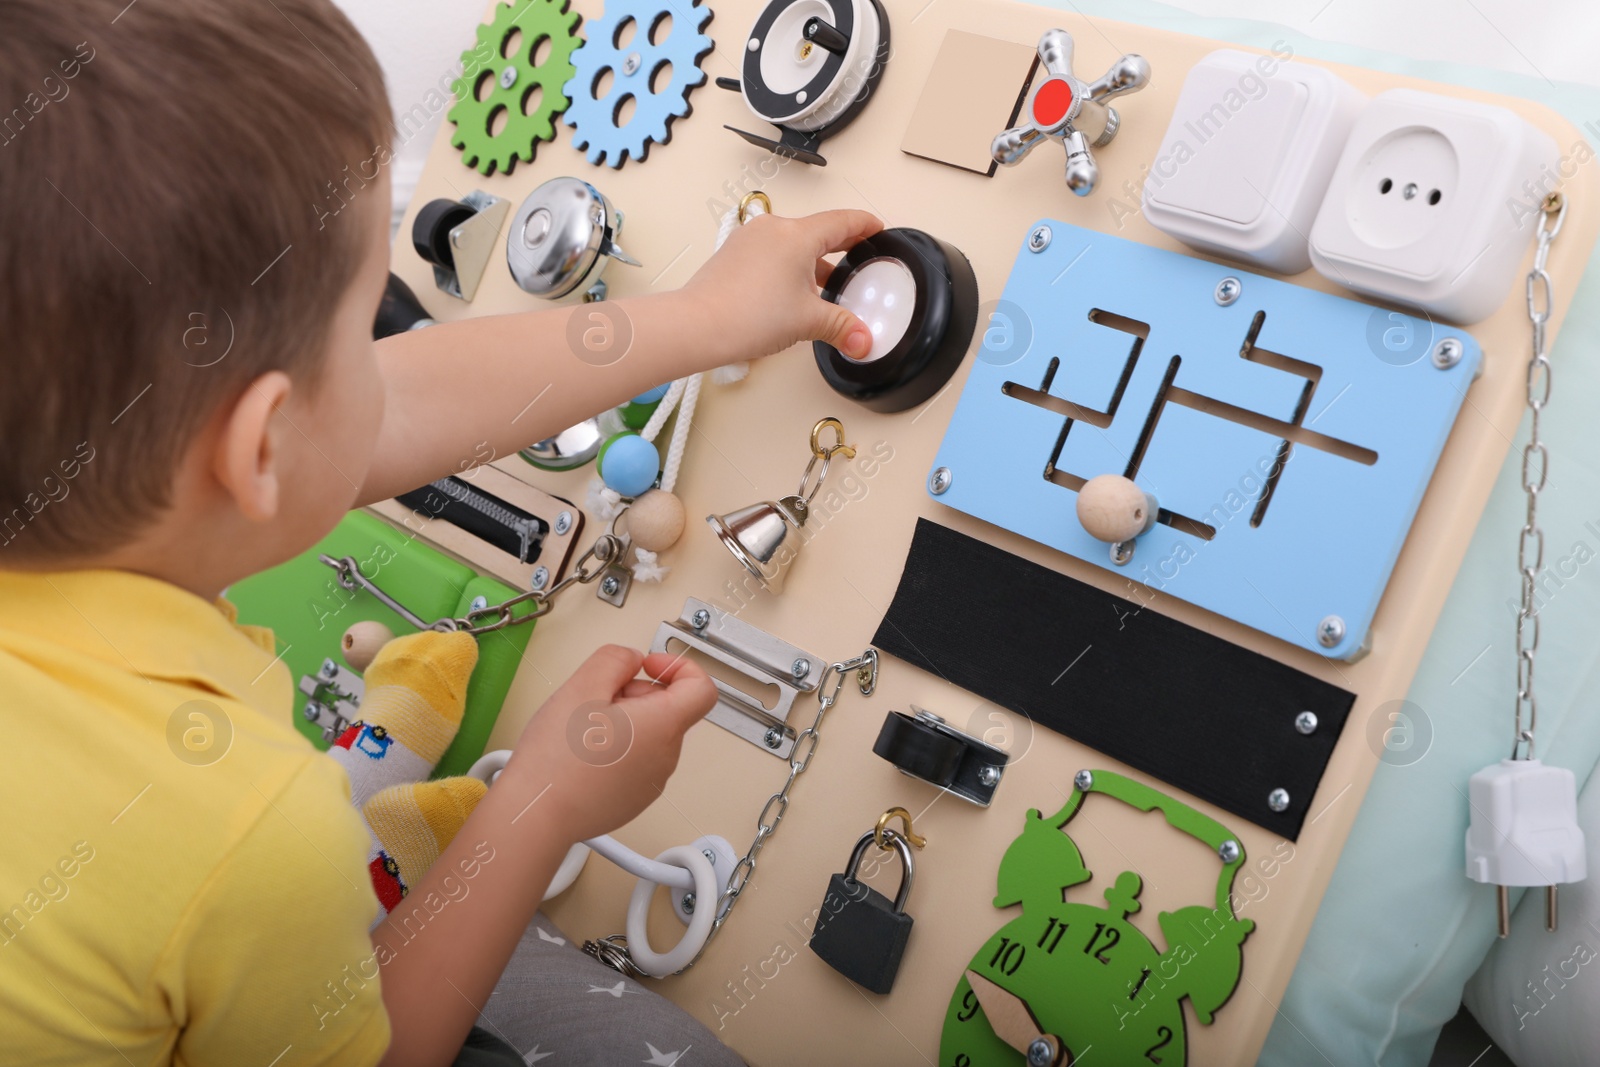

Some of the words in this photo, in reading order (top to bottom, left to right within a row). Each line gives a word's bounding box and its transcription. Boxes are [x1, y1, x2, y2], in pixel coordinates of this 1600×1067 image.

[1036, 917, 1069, 954] 11
[1083, 922, 1121, 965] 12
[989, 937, 1026, 977] 10
[1128, 968, 1152, 1001] 1
[957, 988, 981, 1022] 9
[1144, 1025, 1173, 1065] 2
